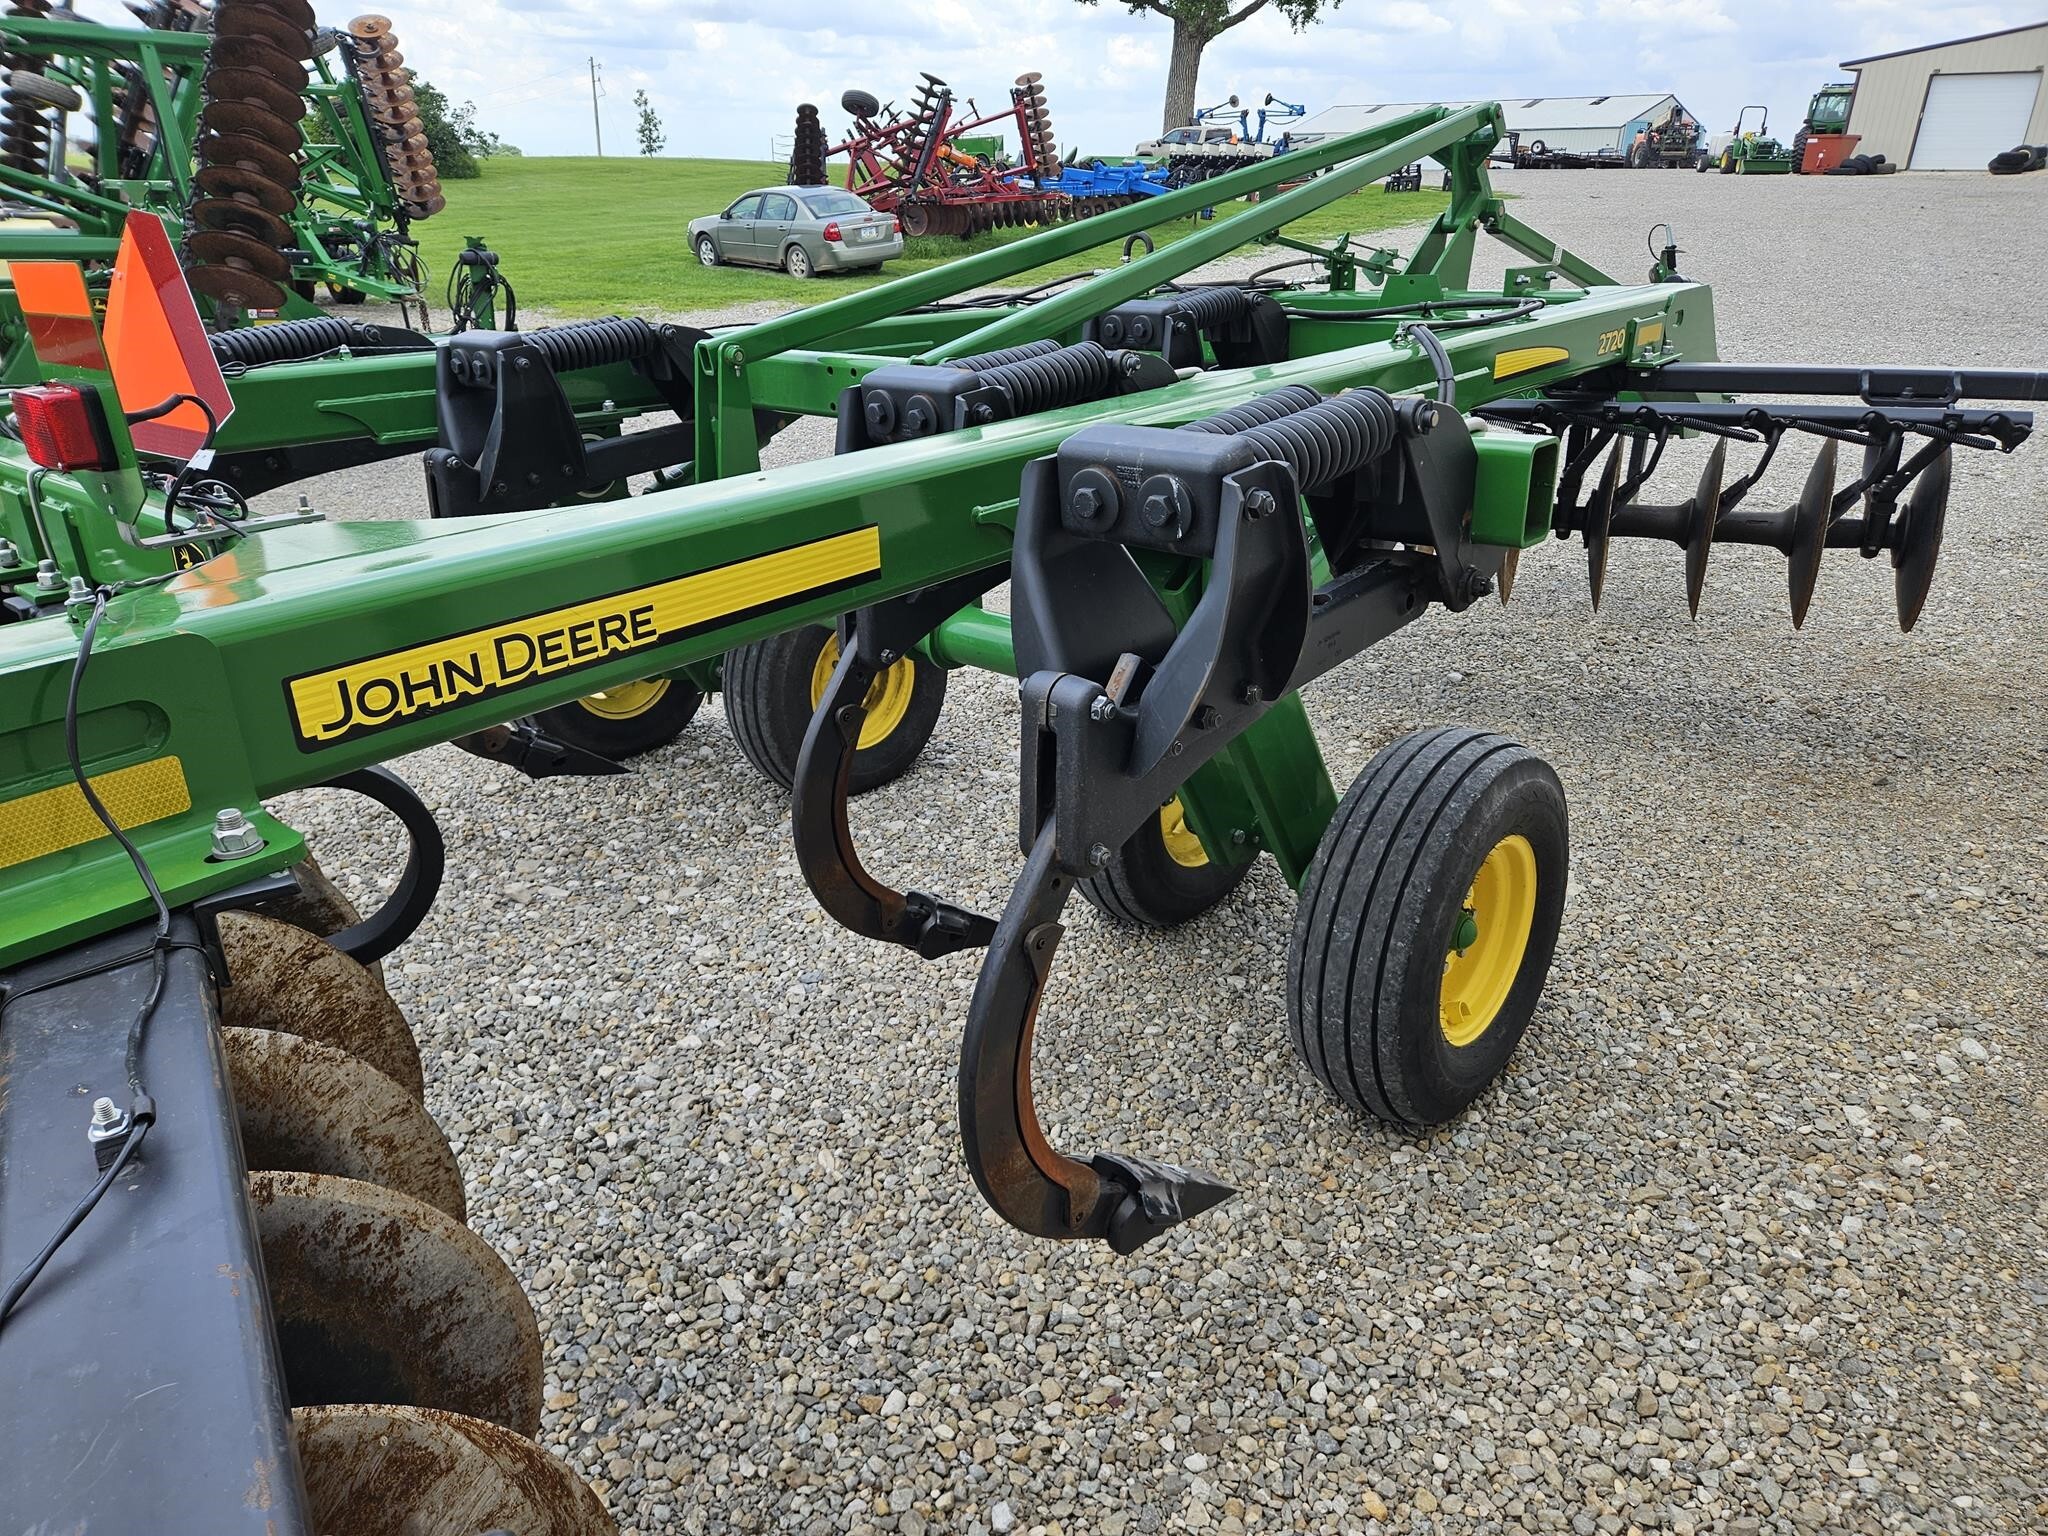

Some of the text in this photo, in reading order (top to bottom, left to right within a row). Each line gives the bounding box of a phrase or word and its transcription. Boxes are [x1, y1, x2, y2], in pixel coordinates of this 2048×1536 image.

[1597, 328, 1626, 356] 2720
[321, 604, 658, 734] JOHN DEERE
